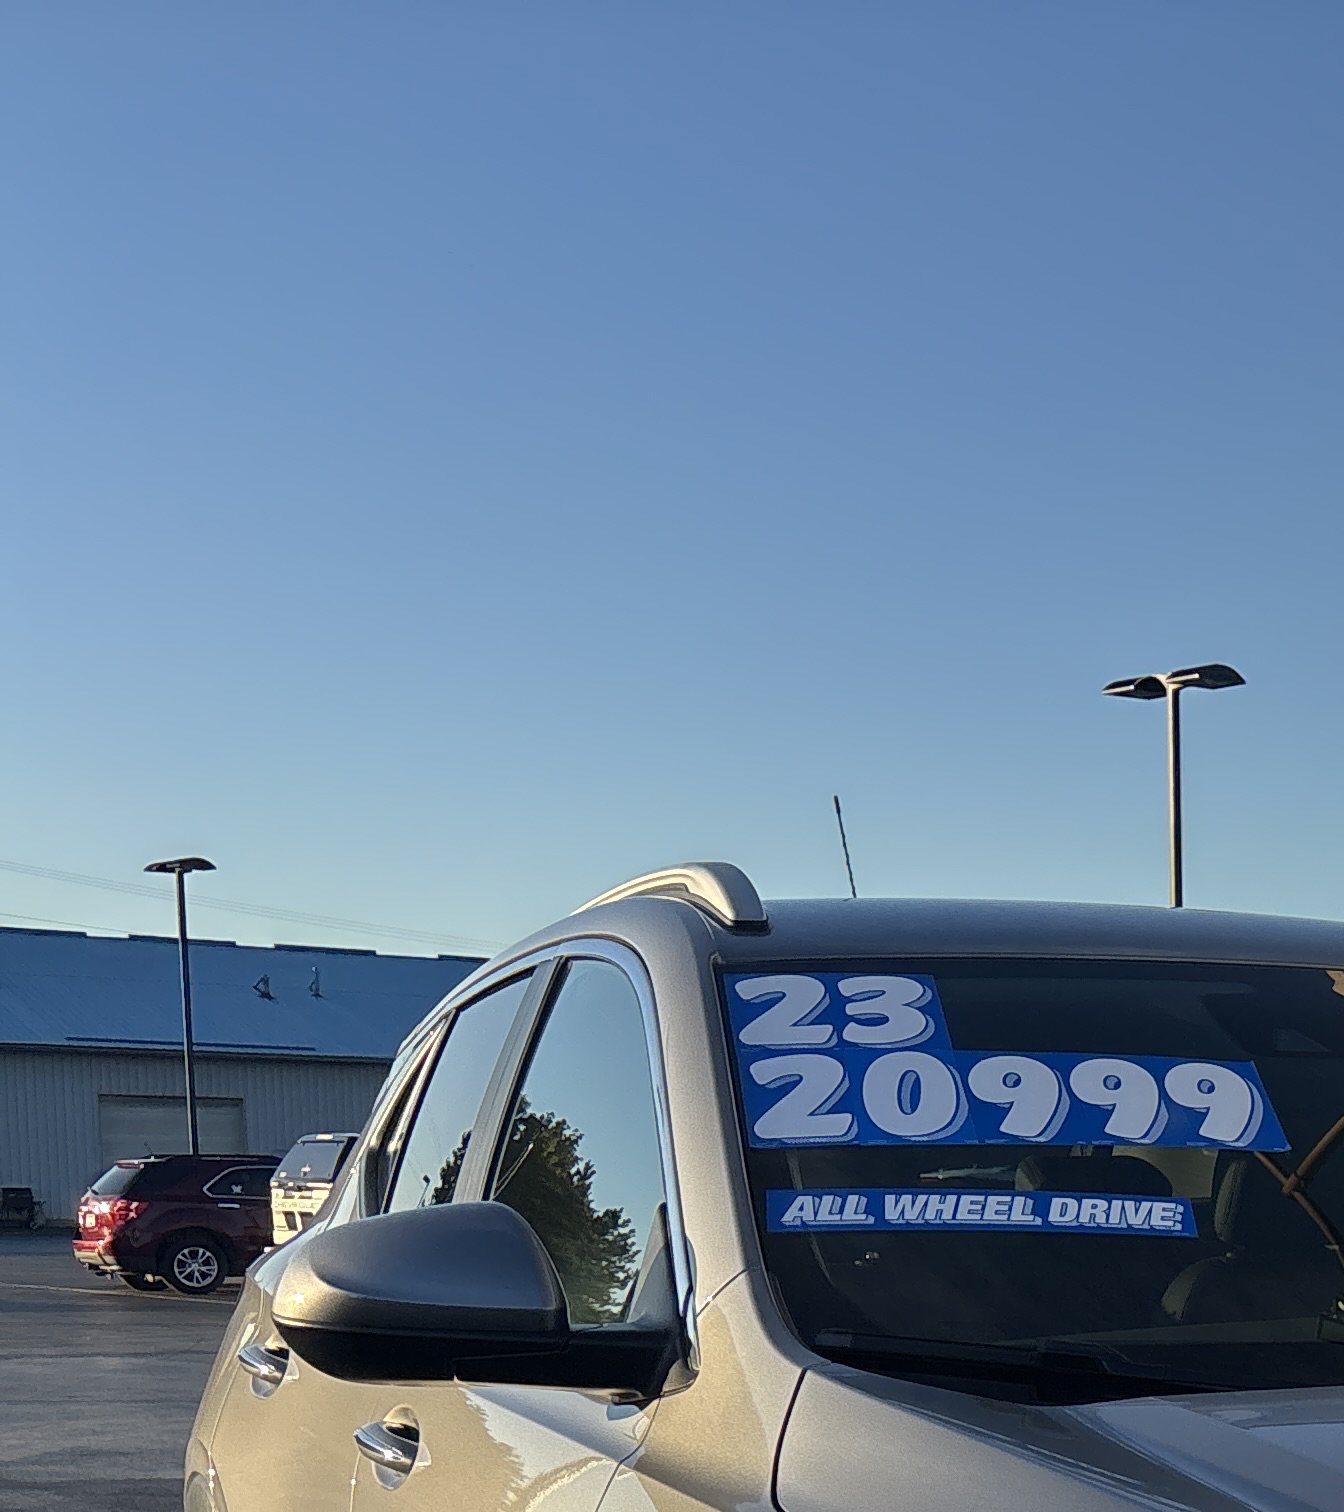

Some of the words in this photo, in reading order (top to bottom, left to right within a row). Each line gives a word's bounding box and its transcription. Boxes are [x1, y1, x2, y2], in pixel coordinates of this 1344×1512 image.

[733, 974, 936, 1049] 23
[749, 1051, 1264, 1147] 20999
[780, 1194, 875, 1225] ALL
[884, 1194, 1043, 1227] WHEEL
[1047, 1197, 1184, 1231] DRIVE
